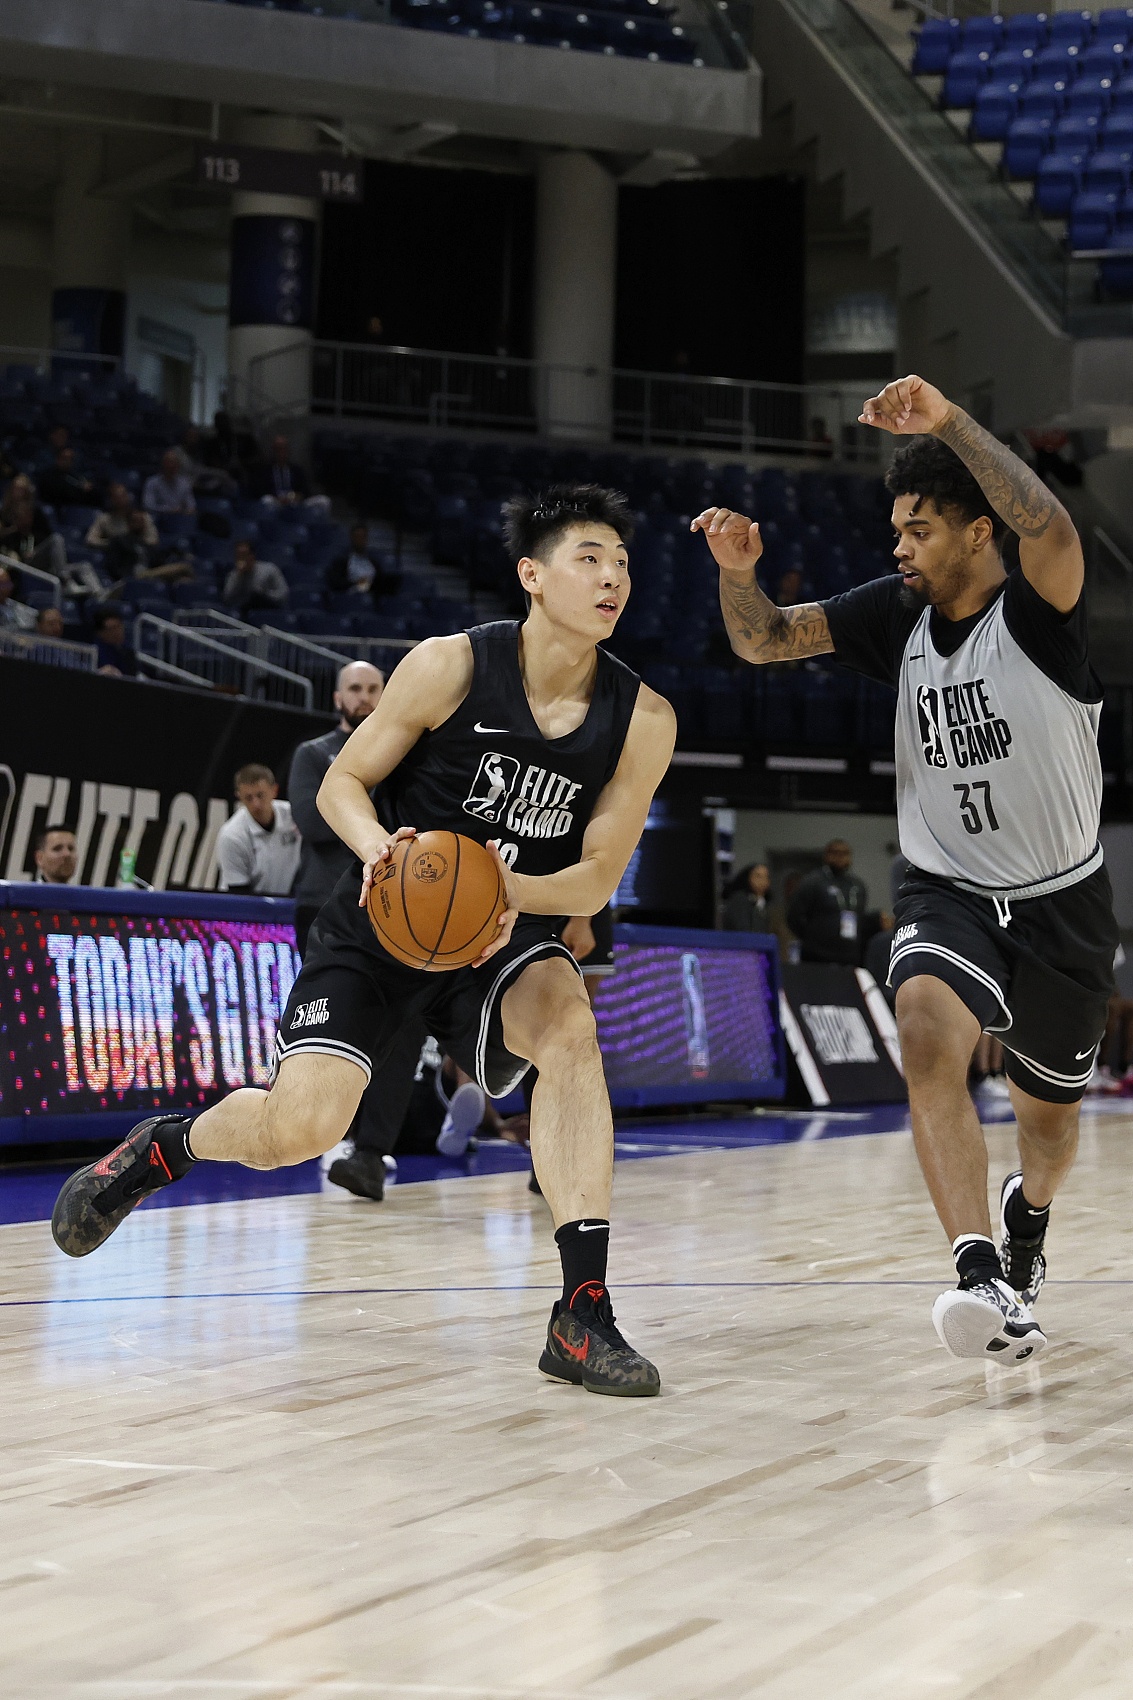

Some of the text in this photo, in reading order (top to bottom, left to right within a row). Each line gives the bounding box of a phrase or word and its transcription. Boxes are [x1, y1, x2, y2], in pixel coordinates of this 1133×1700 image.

[204, 157, 241, 183] 113
[319, 169, 356, 195] 114
[941, 678, 995, 728] ELITE
[950, 718, 1012, 769] CAMP
[519, 765, 583, 810] ELITE
[953, 780, 999, 834] 37
[506, 797, 574, 839] CAMP
[47, 933, 216, 1092] TODAY'S
[305, 1010, 330, 1026] CAMP
[307, 997, 329, 1014] ELITE
